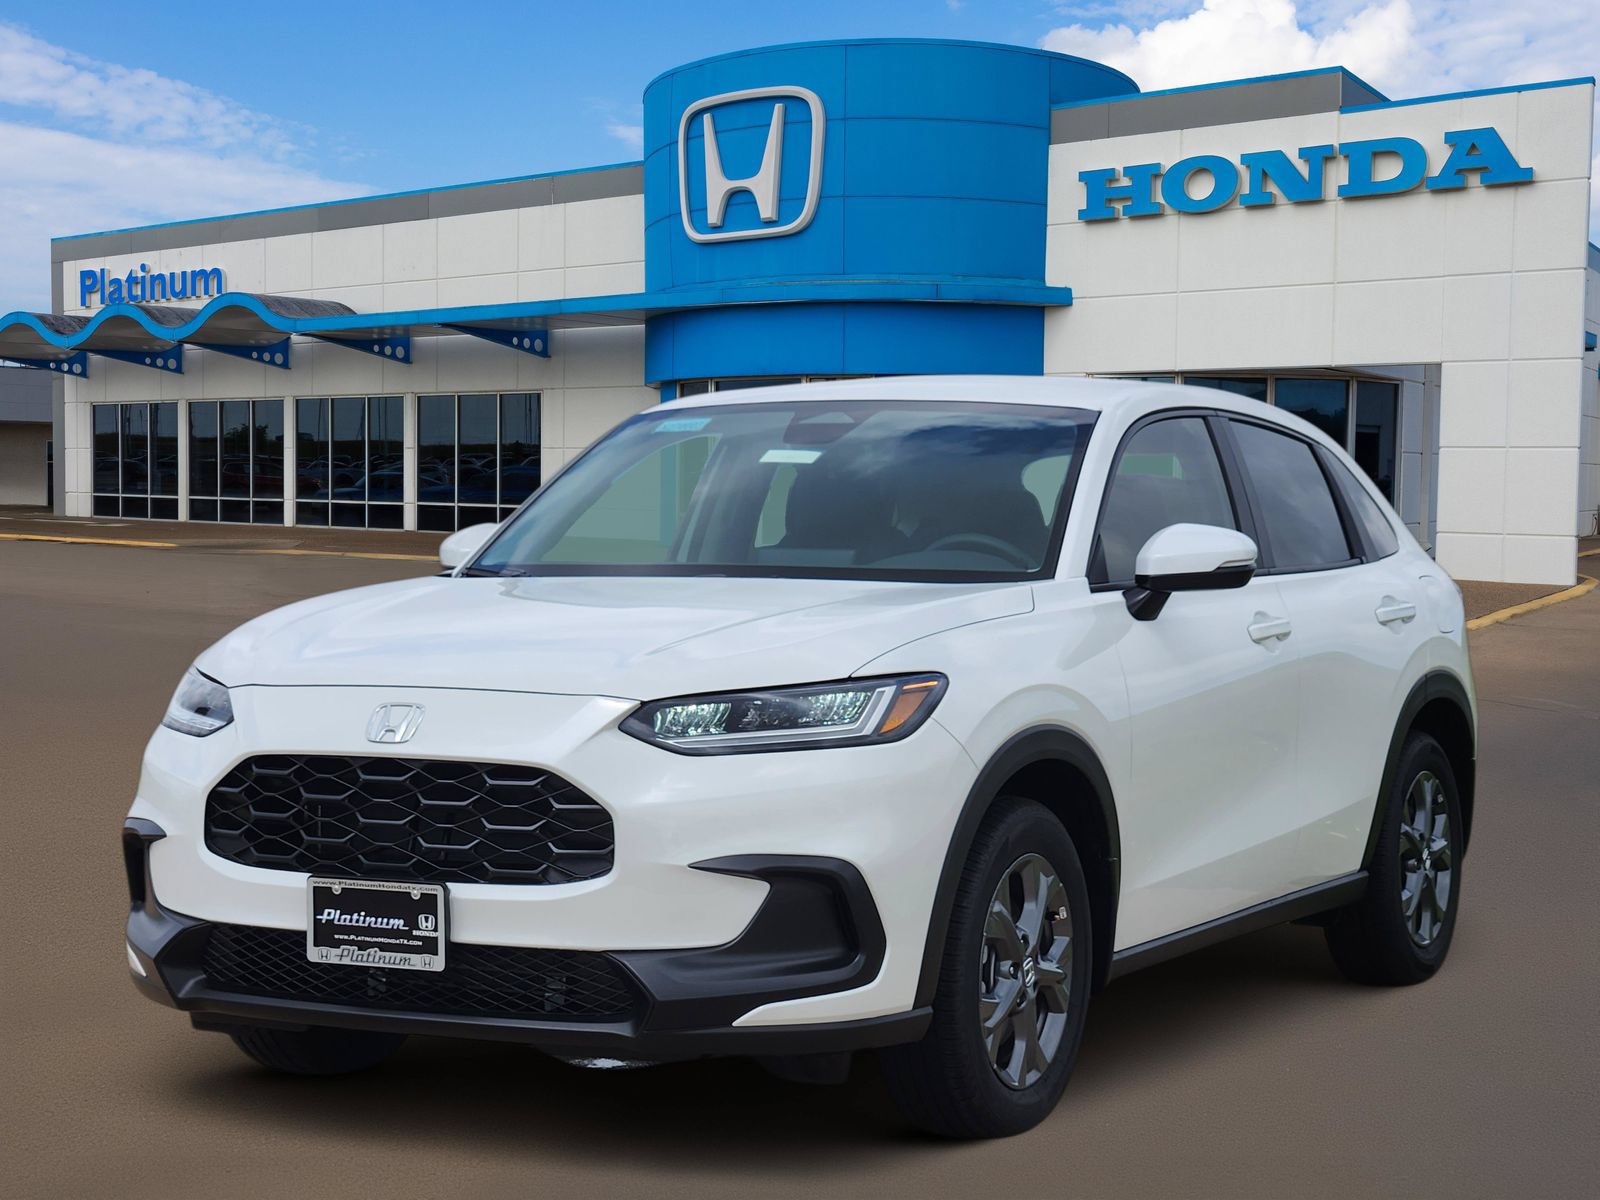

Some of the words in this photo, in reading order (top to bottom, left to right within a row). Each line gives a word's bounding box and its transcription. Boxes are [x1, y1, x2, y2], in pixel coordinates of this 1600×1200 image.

[1078, 126, 1534, 221] HONDA
[79, 263, 224, 307] Platinum
[316, 909, 410, 930] Platinum
[334, 947, 418, 967] Platinum
